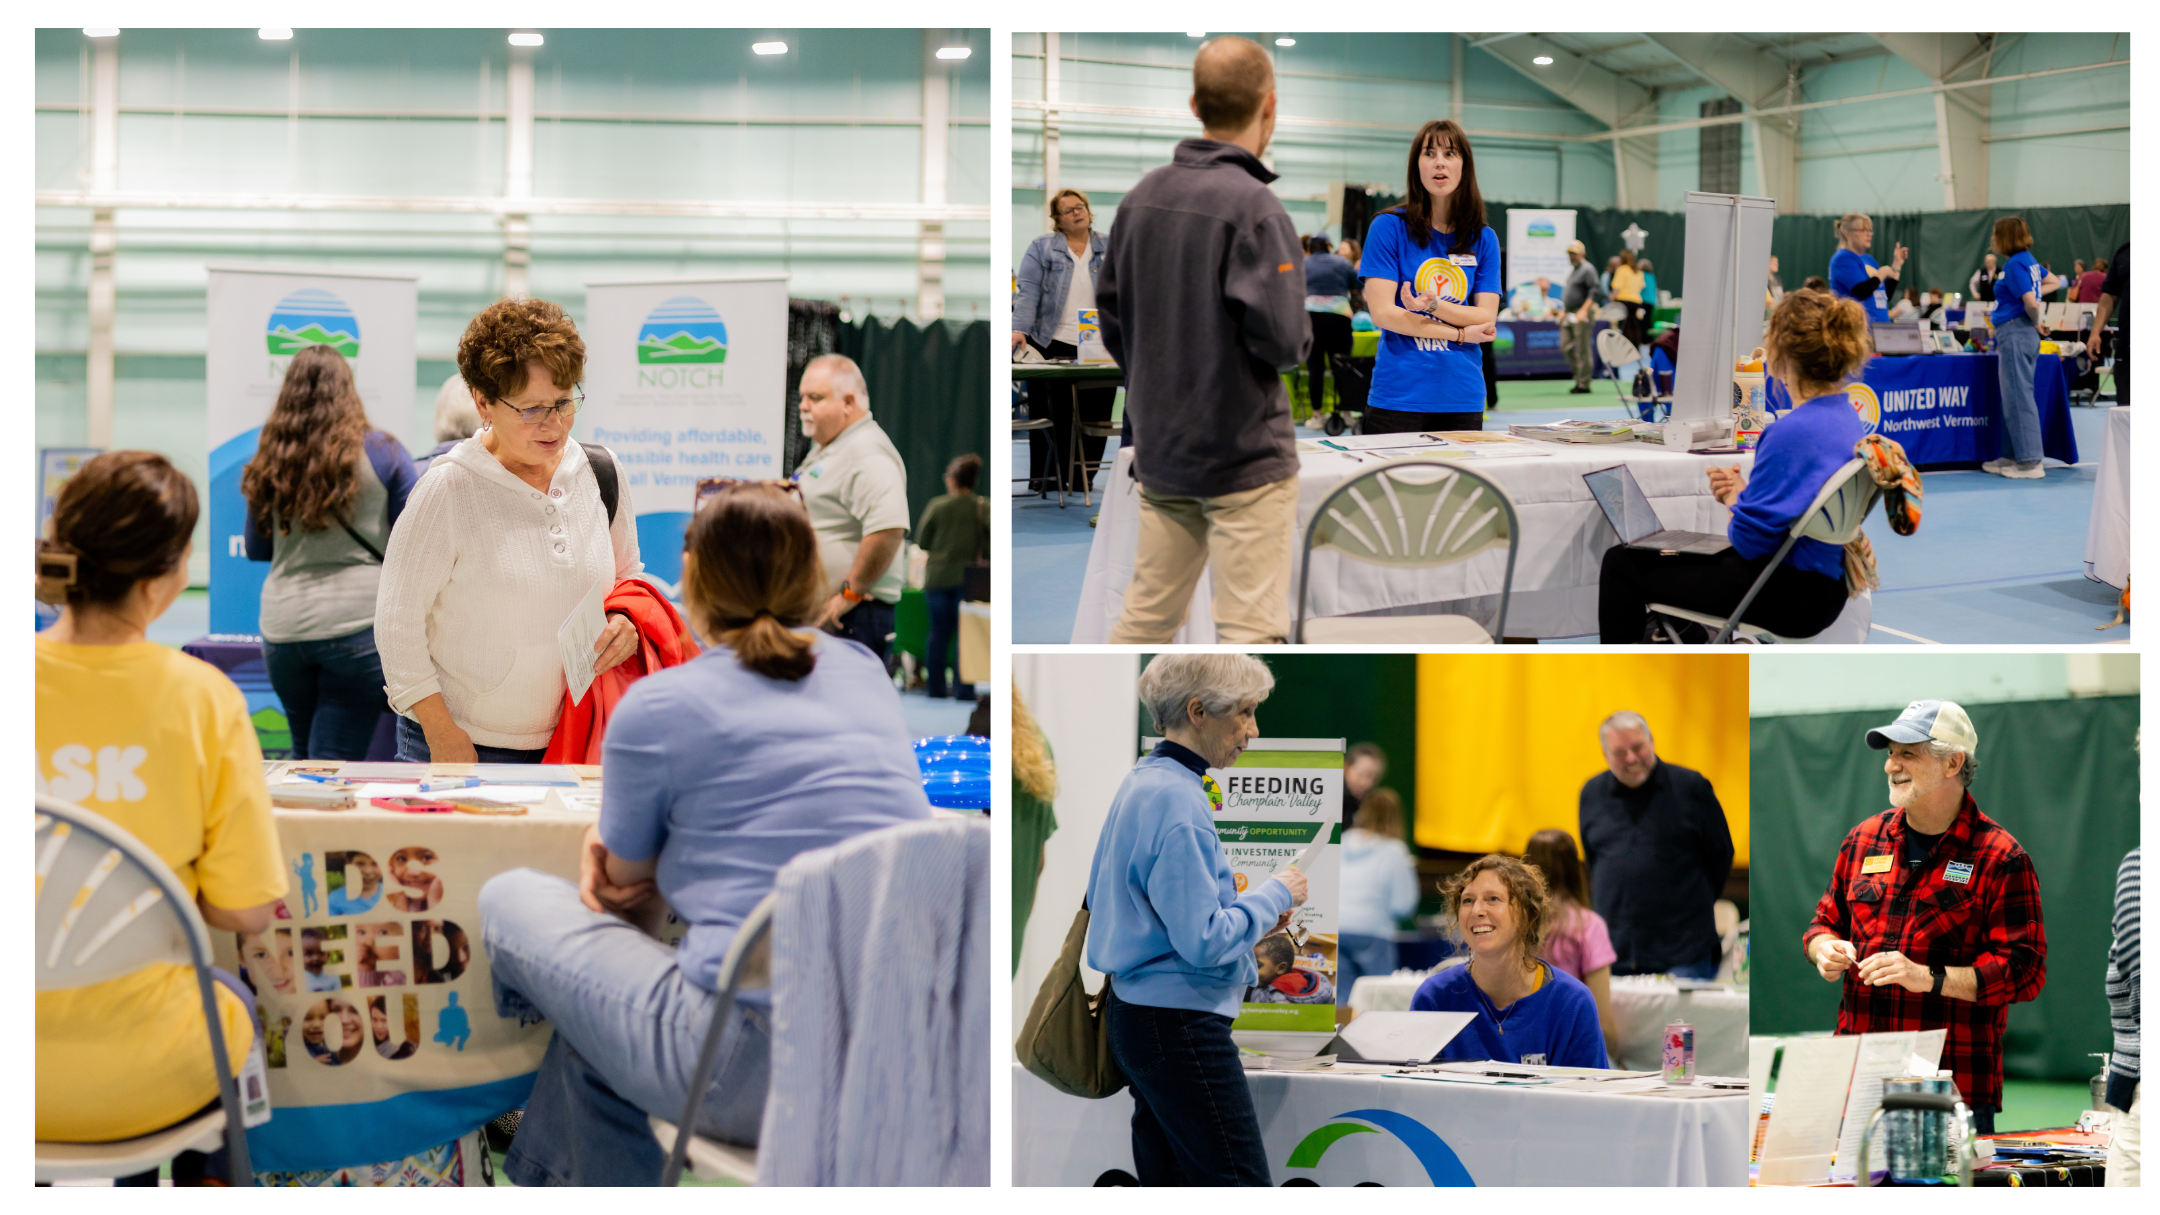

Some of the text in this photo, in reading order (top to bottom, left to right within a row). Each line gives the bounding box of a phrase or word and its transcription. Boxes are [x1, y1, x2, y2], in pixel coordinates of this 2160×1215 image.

[637, 367, 725, 389] NOTCH
[1883, 386, 1969, 413] UNITED WAY
[1883, 414, 1989, 433] Northwest Vermont
[594, 427, 767, 446] Providing affordable,
[617, 451, 772, 466] essible health care
[1228, 776, 1324, 795] FEEDING
[1227, 791, 1323, 815] Champlain Valley
[1249, 827, 1308, 836] OPPORTUNITY
[1231, 848, 1297, 857] INVESTMENT
[1230, 857, 1278, 873] Community
[236, 919, 471, 995] NEED
[255, 992, 421, 1069] YOU
